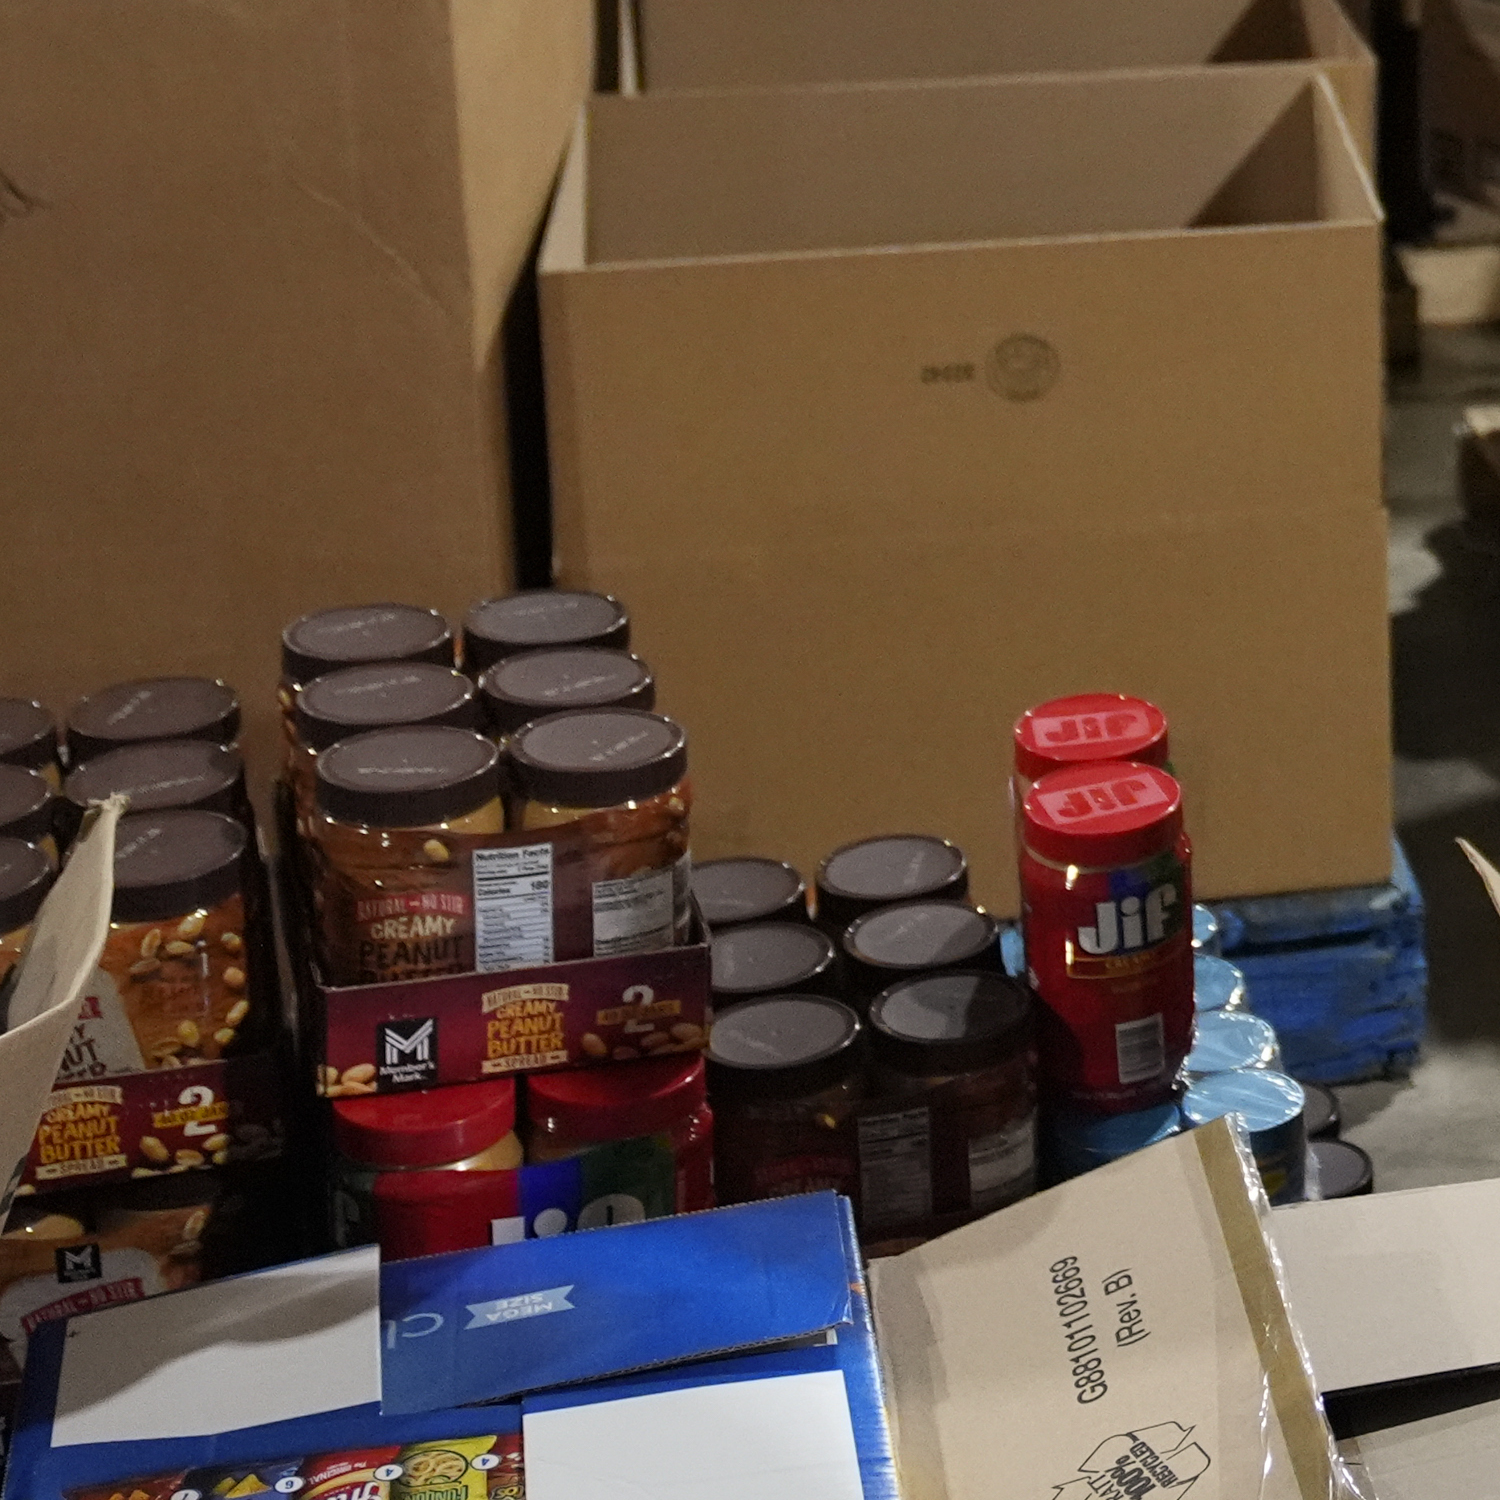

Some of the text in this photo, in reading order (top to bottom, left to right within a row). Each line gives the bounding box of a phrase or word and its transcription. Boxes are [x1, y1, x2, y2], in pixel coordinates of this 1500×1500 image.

[1044, 712, 1137, 743] Jif
[1057, 779, 1147, 818] Jif
[371, 915, 456, 940] CREAMY
[1078, 884, 1177, 955] Jif
[496, 1000, 556, 1019] CREAMY
[622, 984, 655, 1035] 2
[487, 1013, 564, 1040] PEANUT
[487, 1033, 564, 1060] BUTTER
[379, 1061, 435, 1077] Member's
[46, 1102, 110, 1124] CREAMY
[178, 1085, 218, 1137] 2
[39, 1116, 118, 1146] PEANUT
[41, 1135, 121, 1165] BUTTER
[486, 1301, 553, 1323] MEGA
[497, 1292, 544, 1308] SIZE
[1101, 1267, 1151, 1348] (Rev. B)
[1049, 1256, 1108, 1404] G88101102669
[1129, 1441, 1178, 1488] RECYCLED
